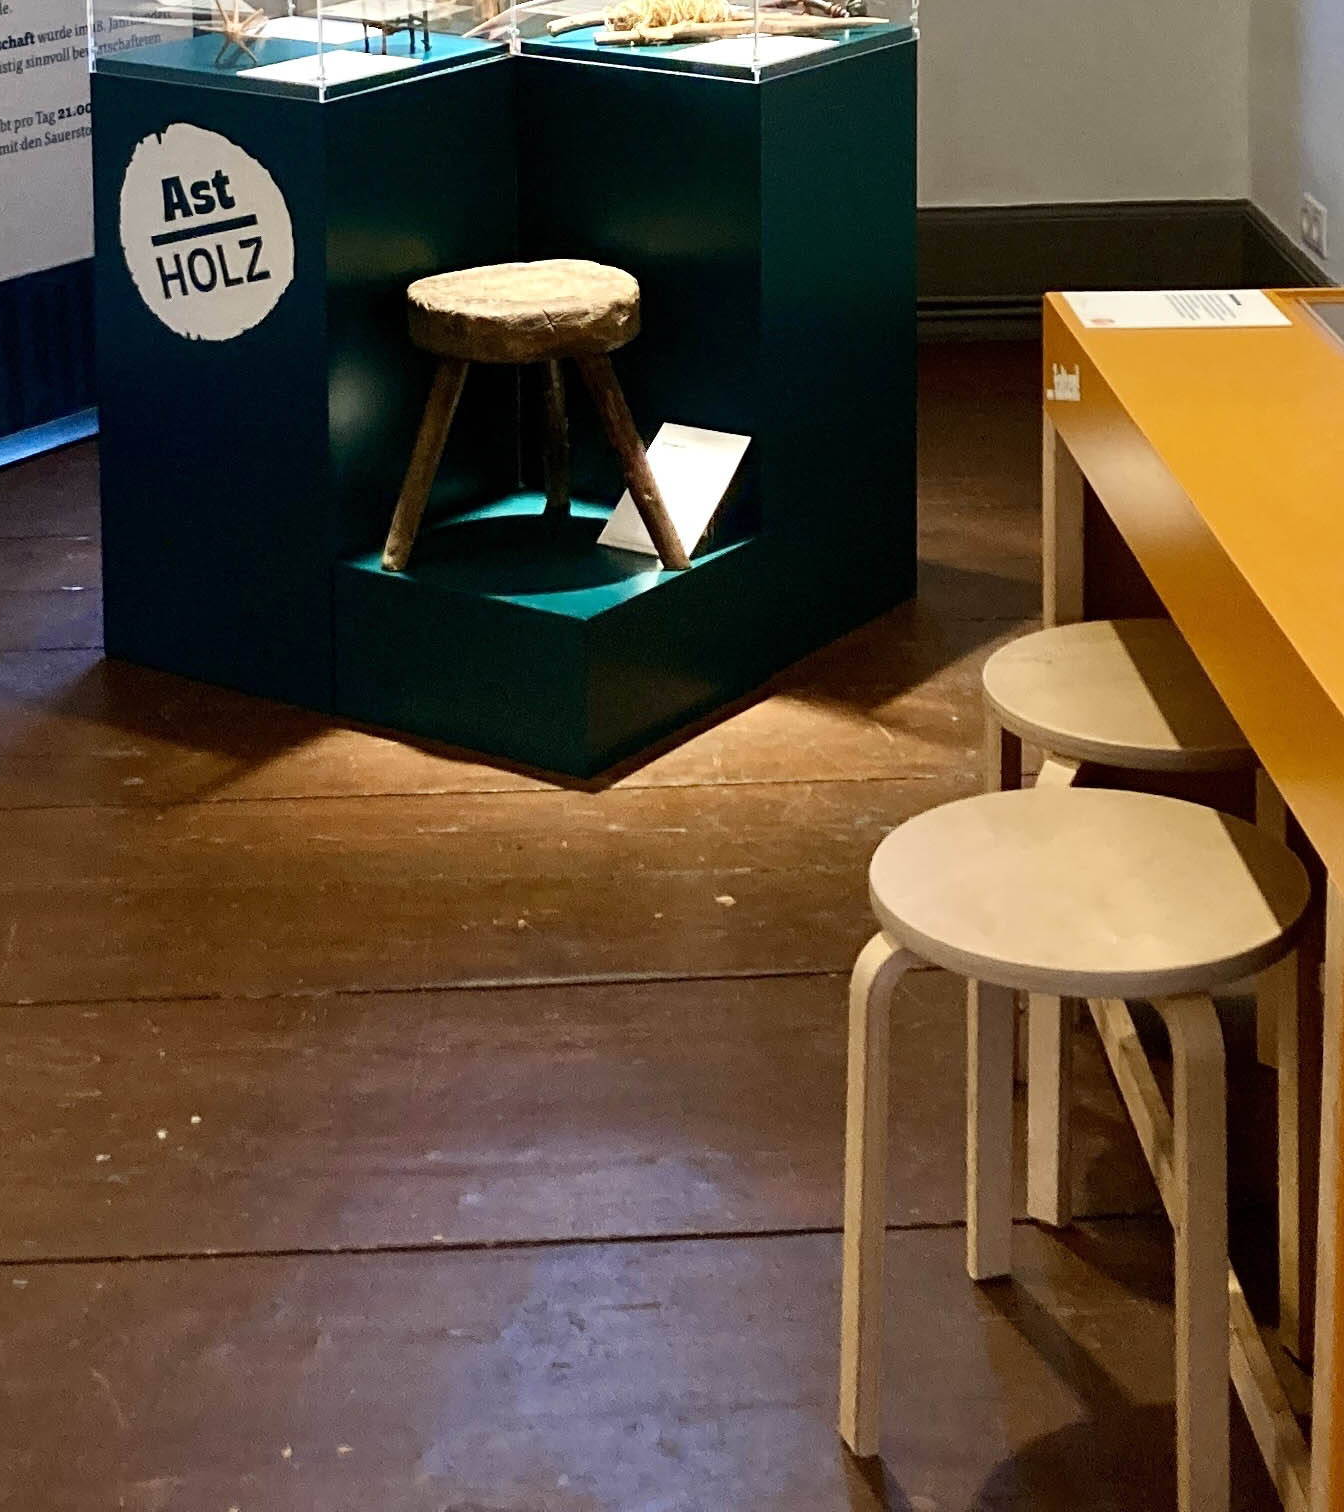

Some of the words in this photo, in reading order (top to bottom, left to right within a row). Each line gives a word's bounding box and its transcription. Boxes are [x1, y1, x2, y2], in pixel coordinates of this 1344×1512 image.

[38, 27, 72, 42] wurde
[25, 51, 70, 69] sinnvoll
[14, 117, 33, 133] pro
[35, 112, 56, 125] Tag
[161, 169, 236, 222] Ast
[156, 236, 271, 300] HOLZ
